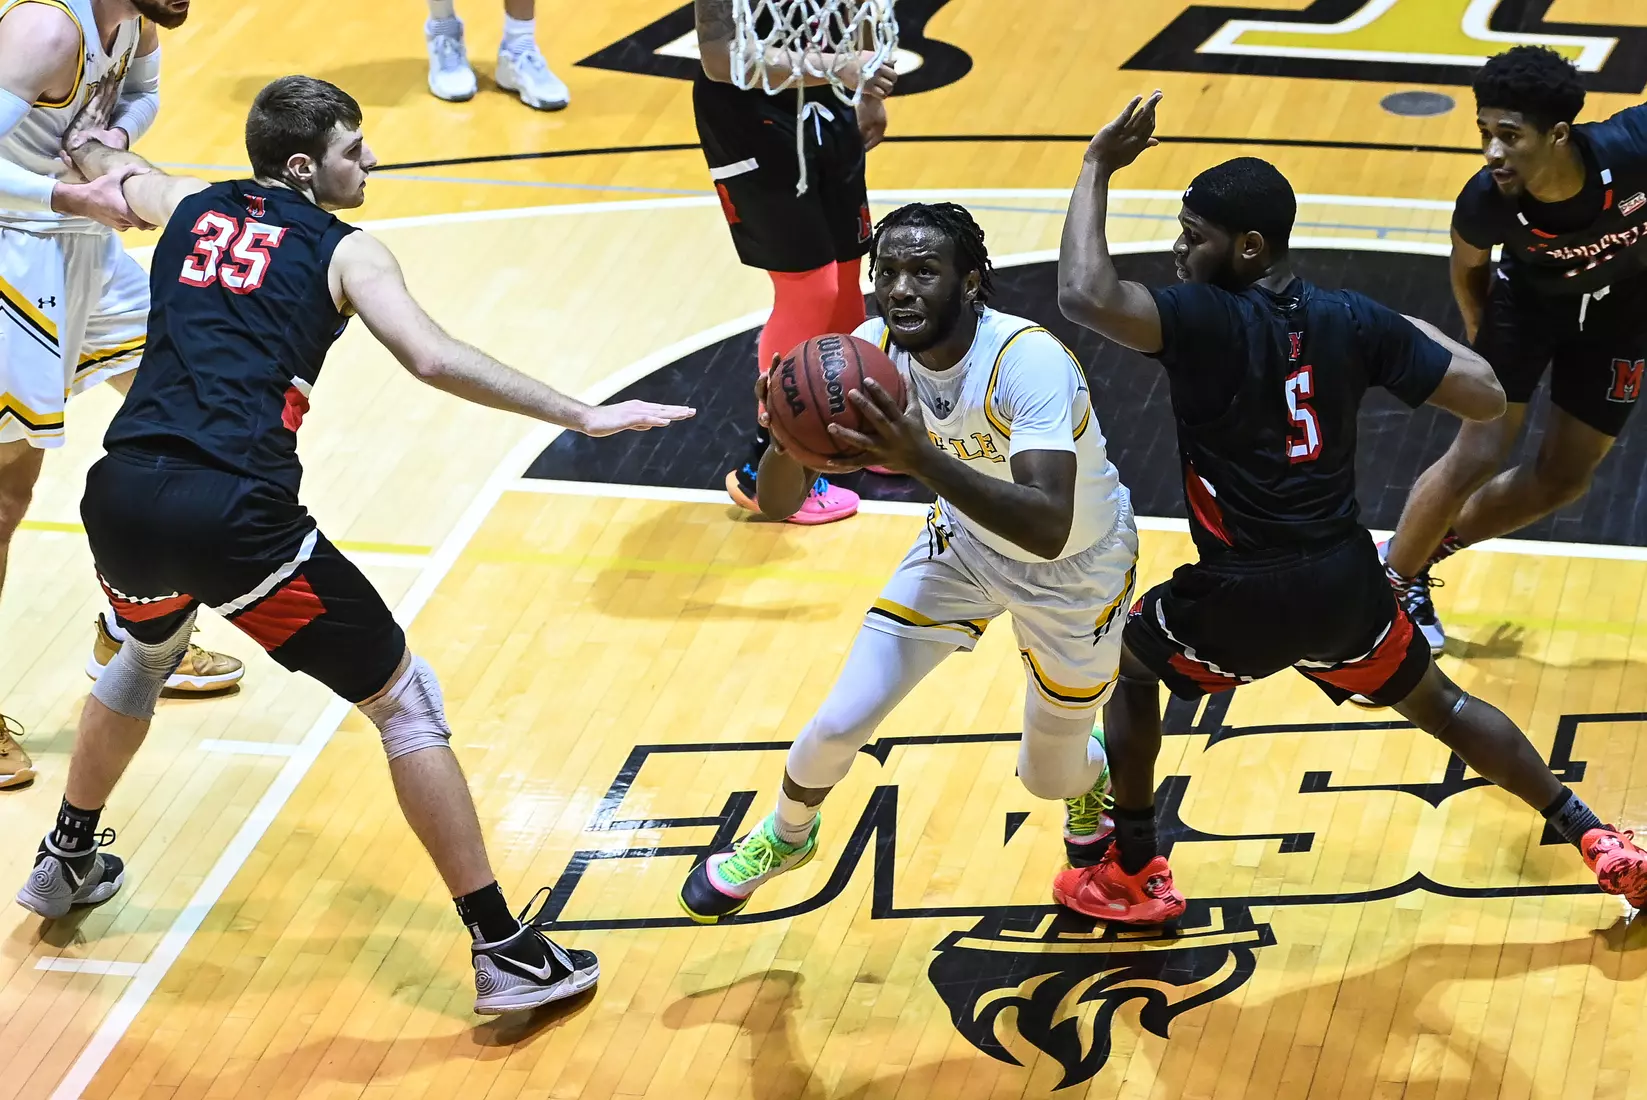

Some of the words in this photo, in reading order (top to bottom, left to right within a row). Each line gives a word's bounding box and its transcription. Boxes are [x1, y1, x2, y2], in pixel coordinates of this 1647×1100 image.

[179, 210, 289, 295] 35
[782, 356, 806, 418] NCAA
[817, 336, 846, 416] Wilson
[1285, 365, 1323, 465] 5
[1606, 358, 1645, 403] M
